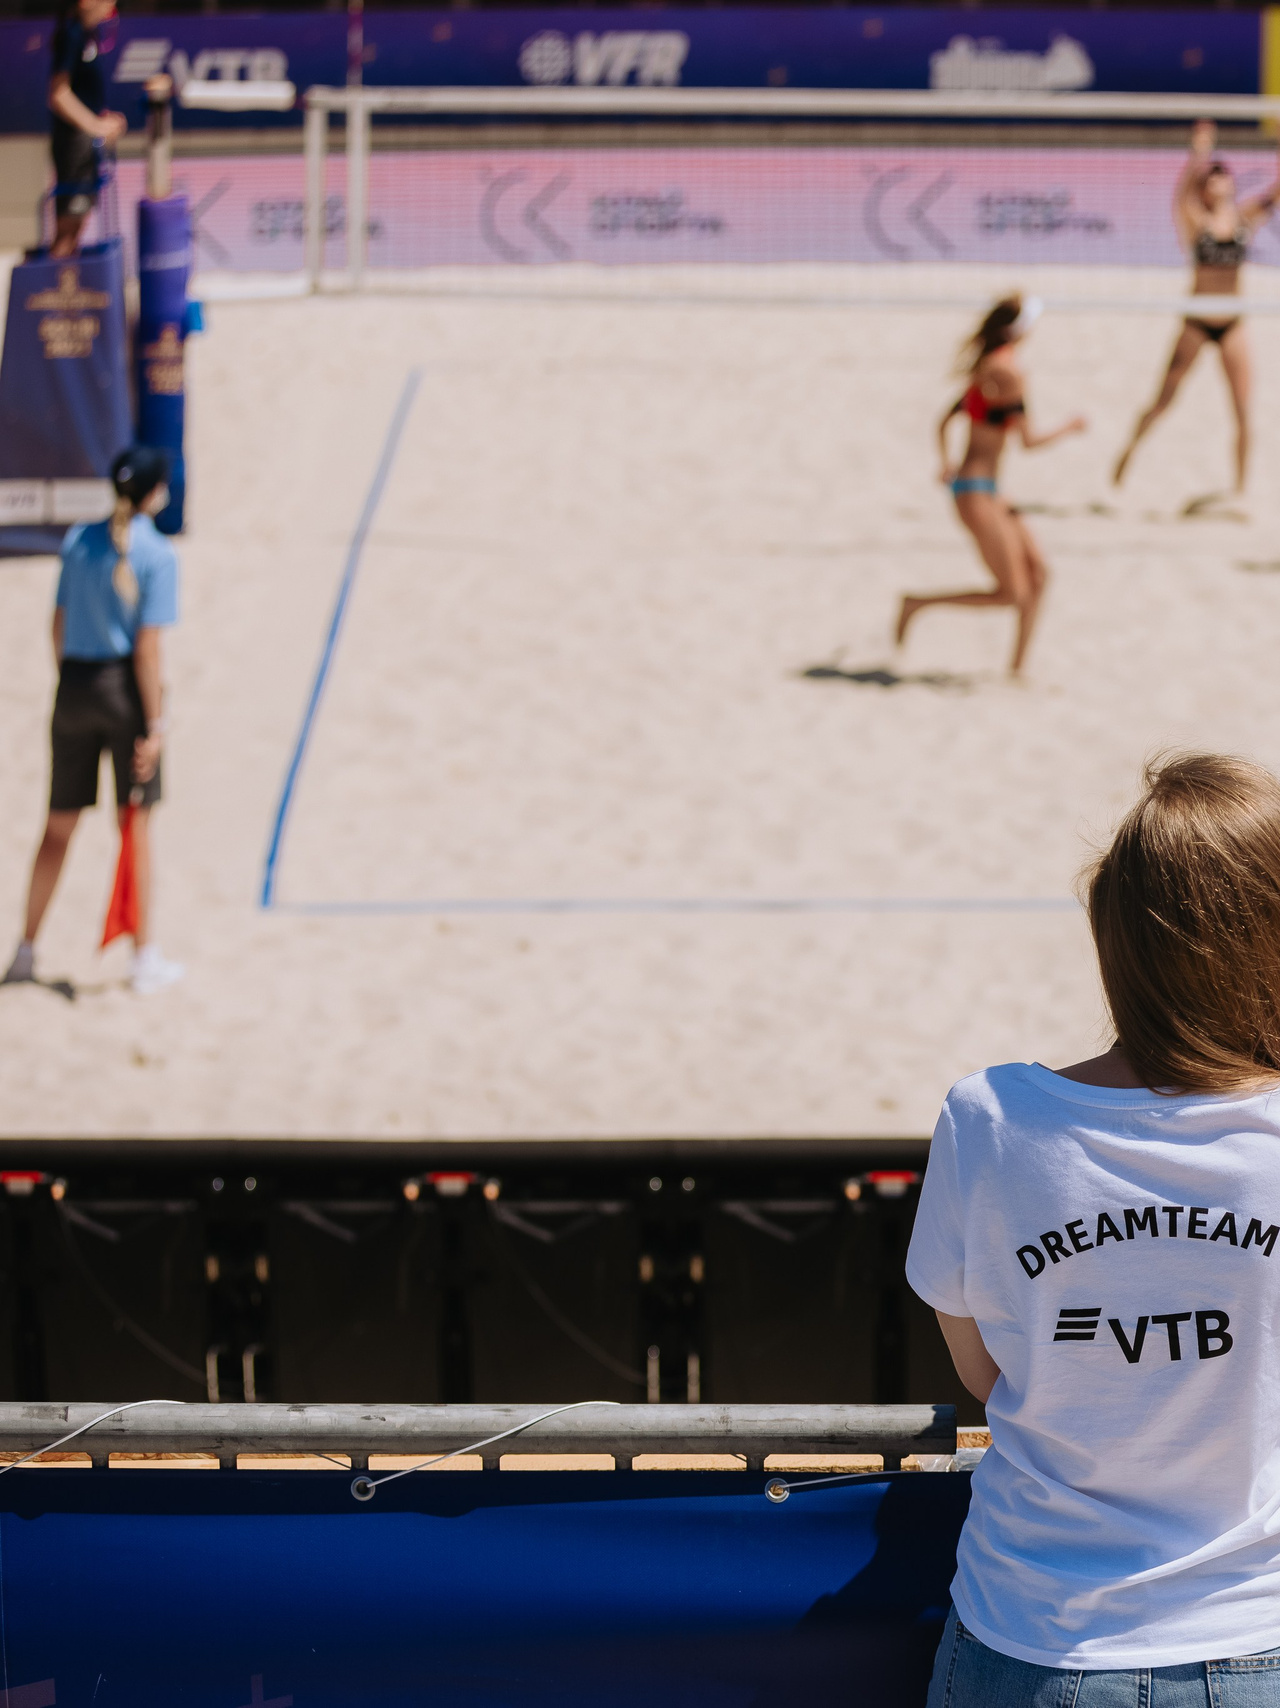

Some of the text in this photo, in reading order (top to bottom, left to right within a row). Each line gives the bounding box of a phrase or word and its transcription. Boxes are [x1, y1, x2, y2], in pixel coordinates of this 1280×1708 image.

[572, 30, 690, 86] VFR
[1015, 1205, 1280, 1280] DREAMTEAM
[1107, 1309, 1234, 1364] VTB
